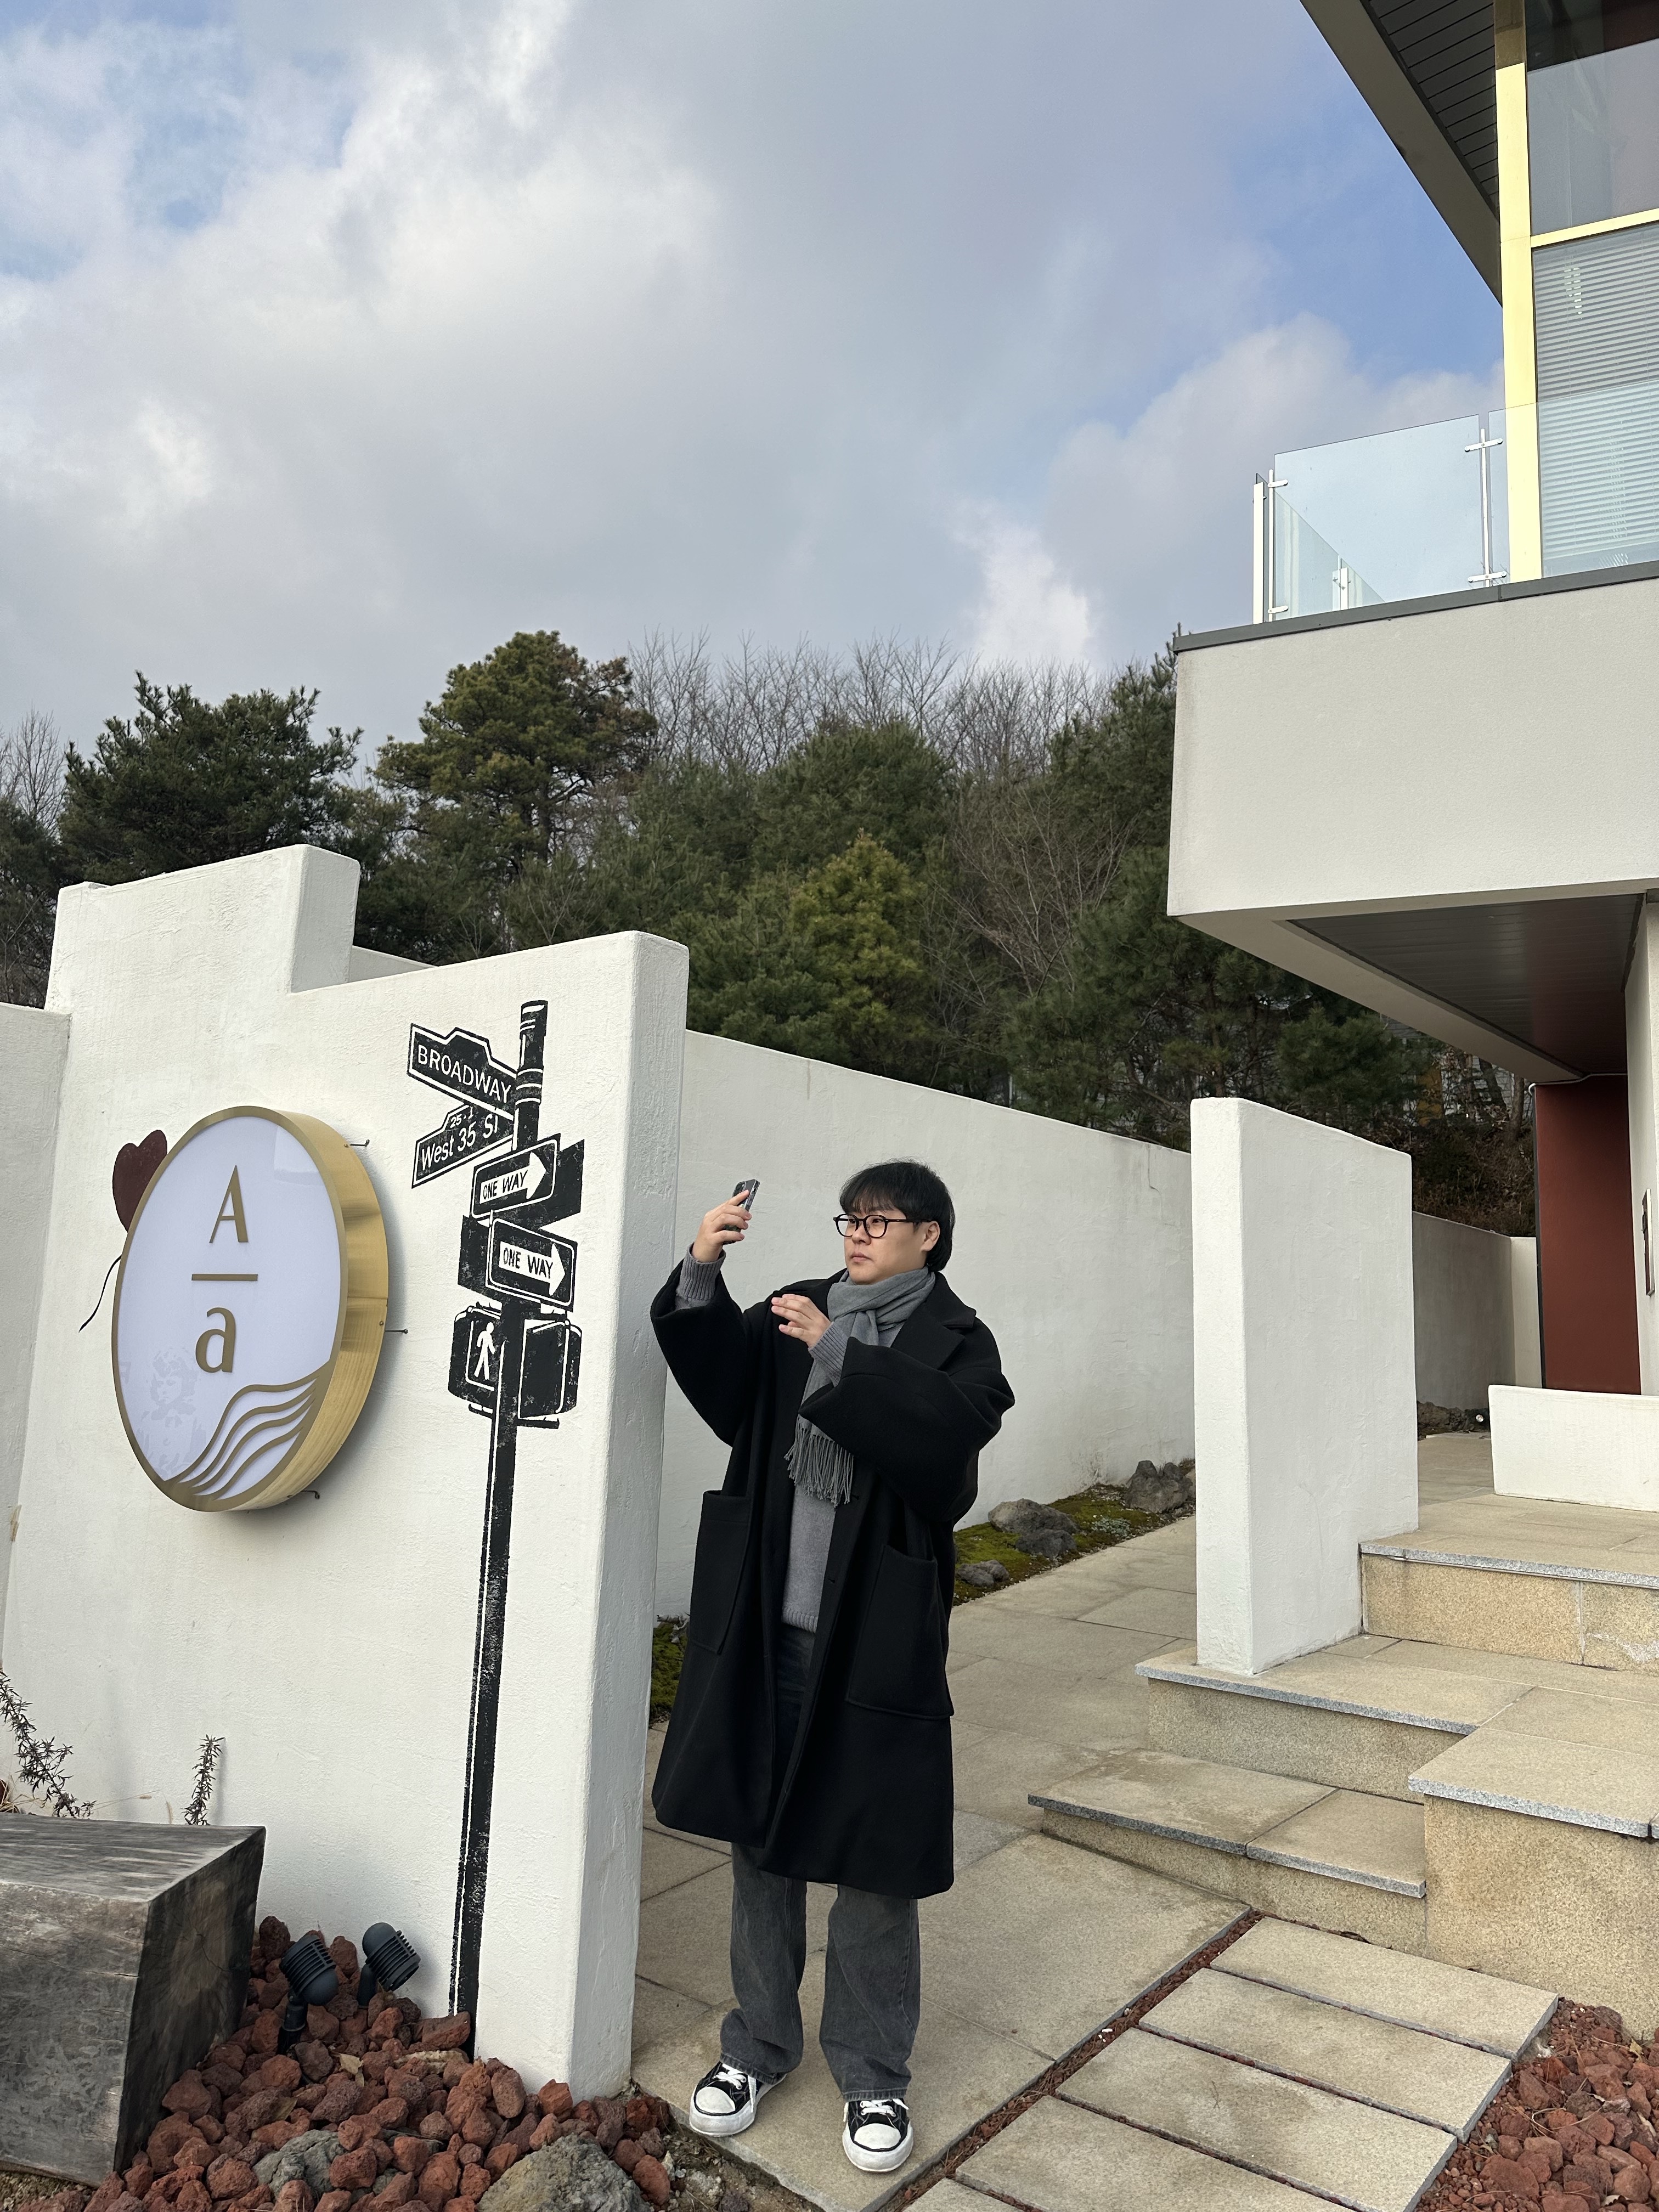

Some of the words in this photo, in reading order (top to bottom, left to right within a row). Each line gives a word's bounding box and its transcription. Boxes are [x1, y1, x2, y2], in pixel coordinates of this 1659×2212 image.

[417, 1044, 511, 1103] BROADWAY
[421, 1135, 455, 1171] West
[457, 1121, 477, 1152] 35
[208, 1165, 249, 1244] A
[483, 1180, 499, 1200] ONE
[502, 1169, 528, 1193] WAY
[503, 1247, 521, 1269] ONE
[527, 1254, 554, 1279] WAY
[195, 1307, 237, 1373] a
